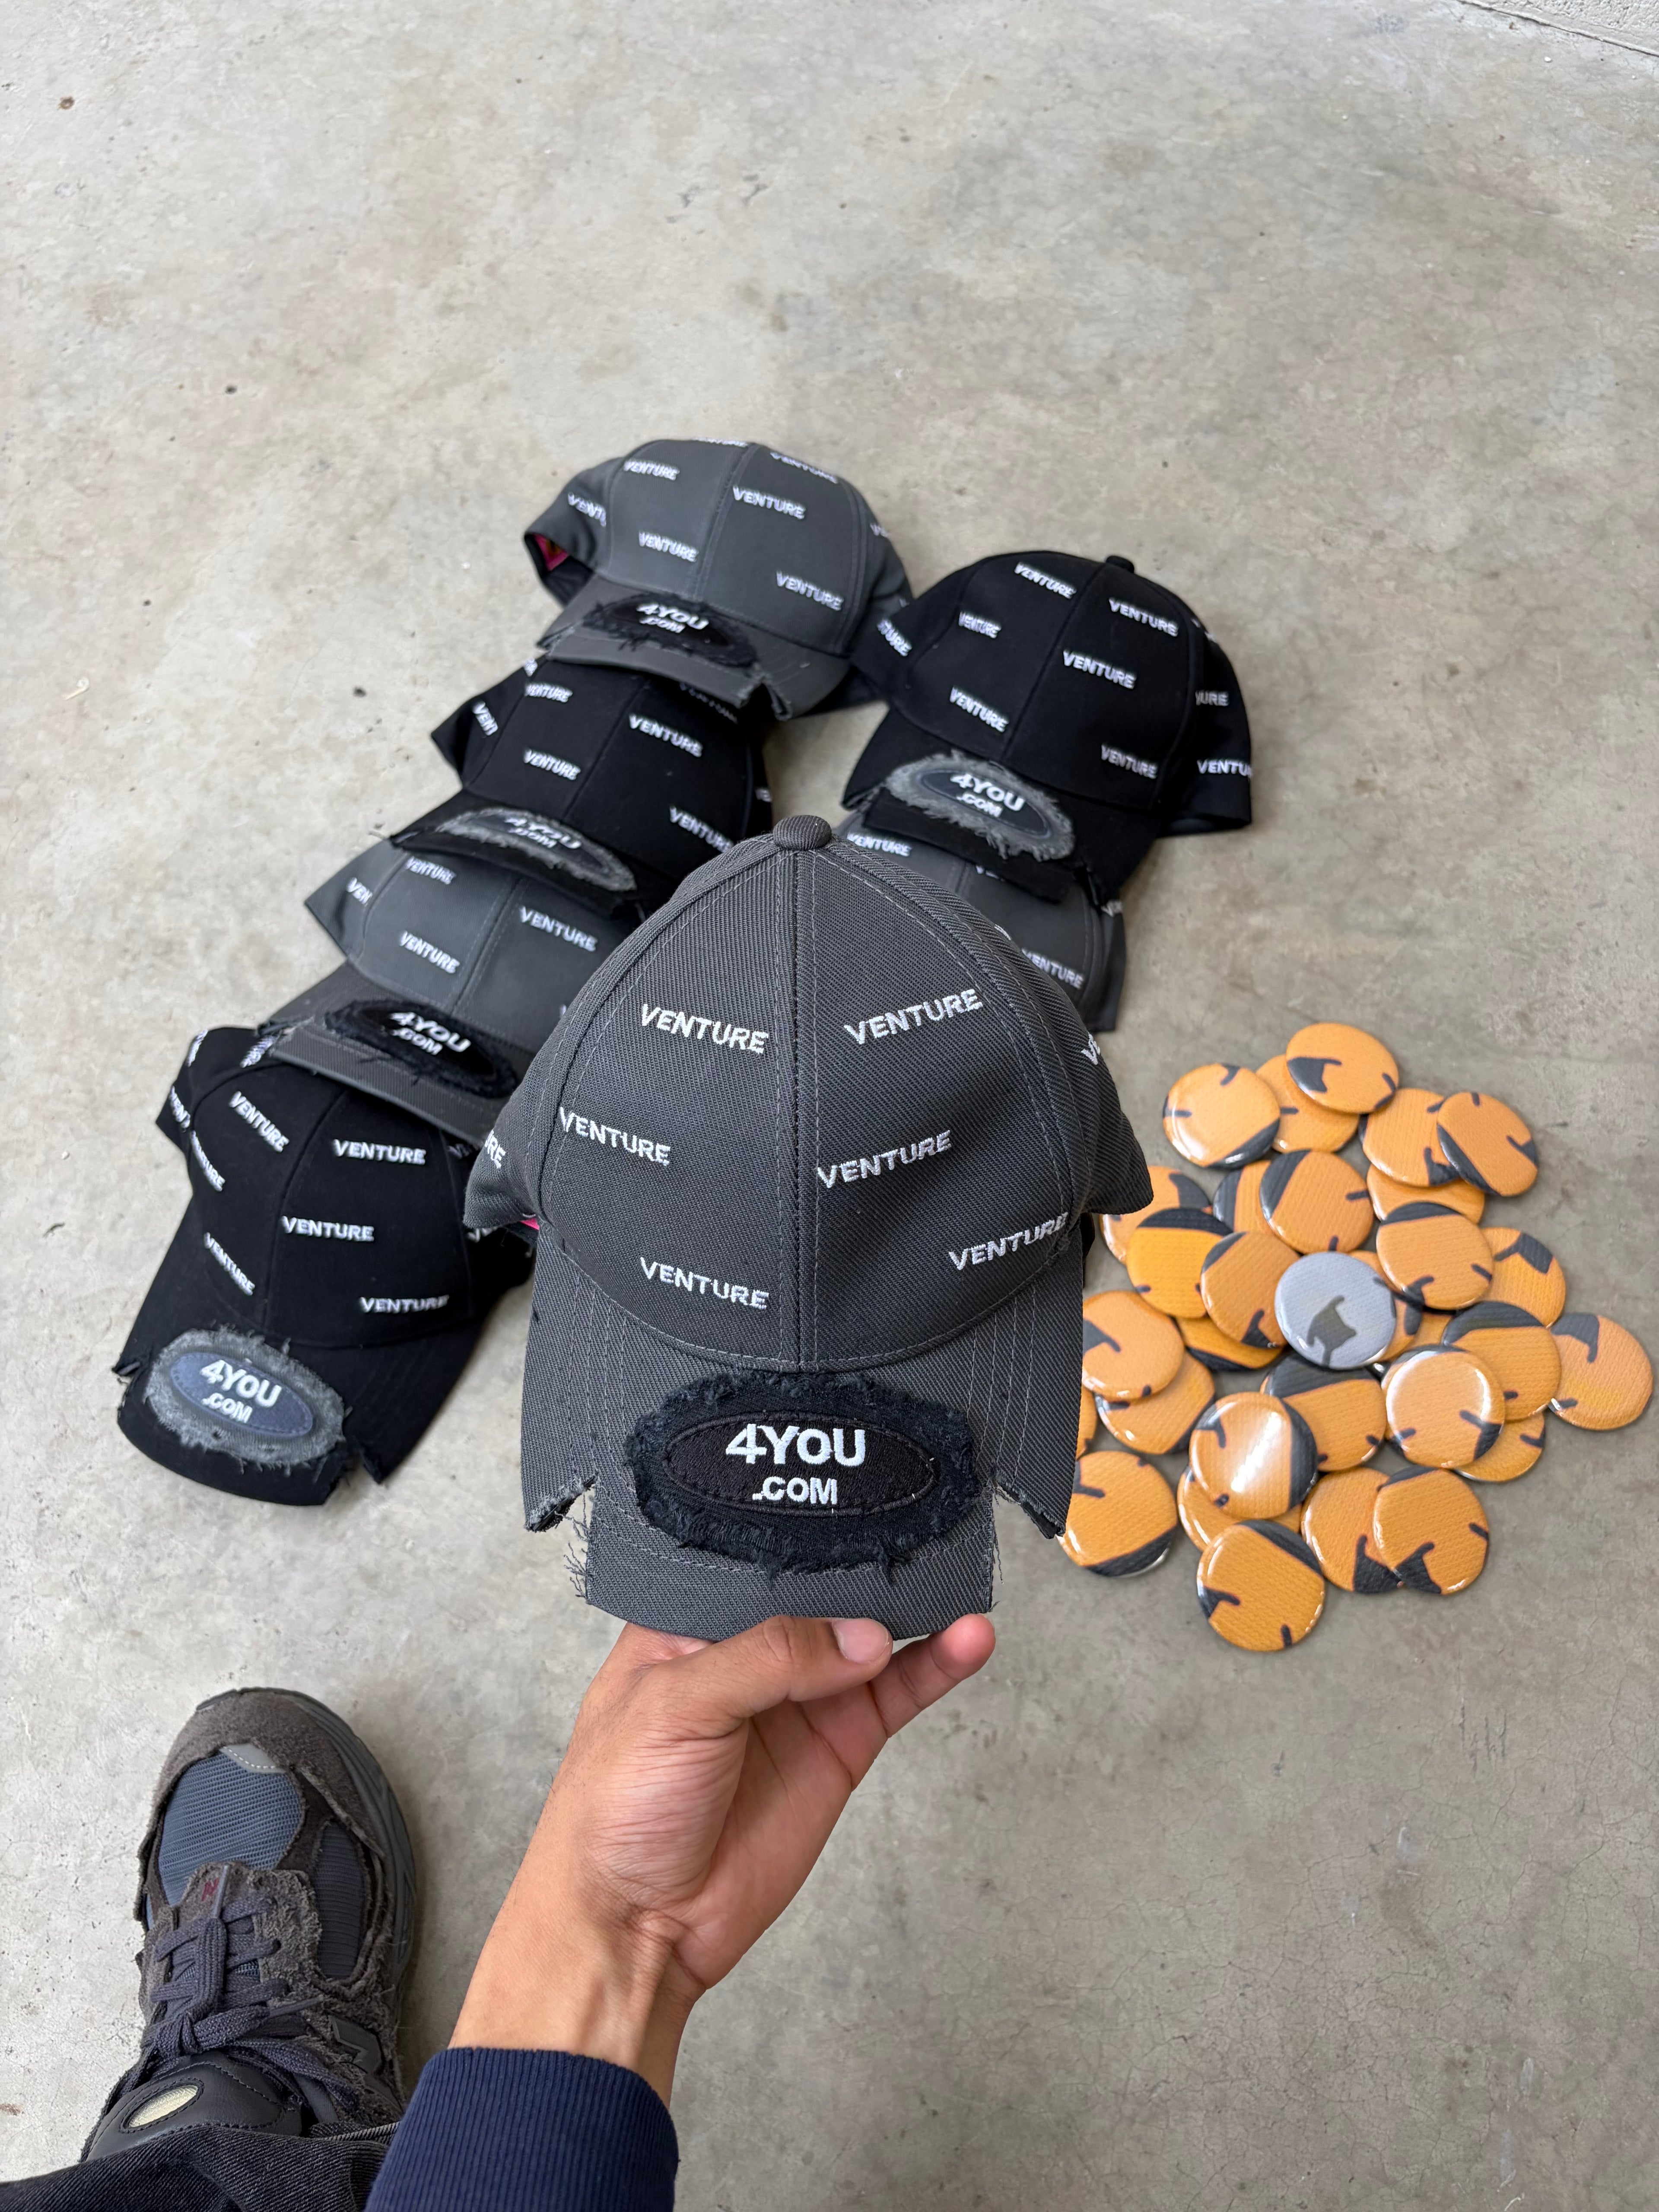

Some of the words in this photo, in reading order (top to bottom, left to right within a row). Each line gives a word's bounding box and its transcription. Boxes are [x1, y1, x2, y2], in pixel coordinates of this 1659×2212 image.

[624, 459, 680, 480] VENTURE
[733, 486, 805, 519] VENTURE
[639, 532, 698, 562] VENTURE
[776, 572, 843, 610] VENTURE
[1015, 563, 1076, 598] VENTURE
[636, 603, 709, 629] 4YOU
[1109, 599, 1178, 636] VENTURE
[1063, 650, 1136, 689] VENTURE
[950, 687, 1008, 732] VENTURE
[629, 714, 703, 758] VENTURE
[524, 750, 580, 780] VENTURE
[1102, 745, 1157, 779] VENTURE
[1197, 759, 1252, 777] VENTU
[950, 773, 1026, 812] 4YOU
[957, 794, 1002, 817] .COM
[406, 856, 456, 884] VENTURE
[519, 906, 597, 951] VENTURE
[400, 931, 459, 973] VENTURE
[391, 1012, 470, 1052] 4YOU
[641, 1004, 769, 1055] VENTURE
[844, 989, 983, 1045] VENTURE
[392, 1028, 443, 1055] .COM
[230, 1091, 289, 1152] VENTURE
[559, 1106, 671, 1166] VENTURE
[333, 1139, 426, 1164] VENTURE
[817, 1130, 951, 1188] VENTURE
[281, 1216, 374, 1241] VENTURE
[204, 1233, 255, 1295] VENTURE
[640, 1257, 769, 1309] VENTURE
[200, 1360, 282, 1407] 4YOU
[201, 1393, 253, 1423] .COM
[725, 1424, 866, 1467] 4YOU
[752, 1476, 837, 1504] .COM
